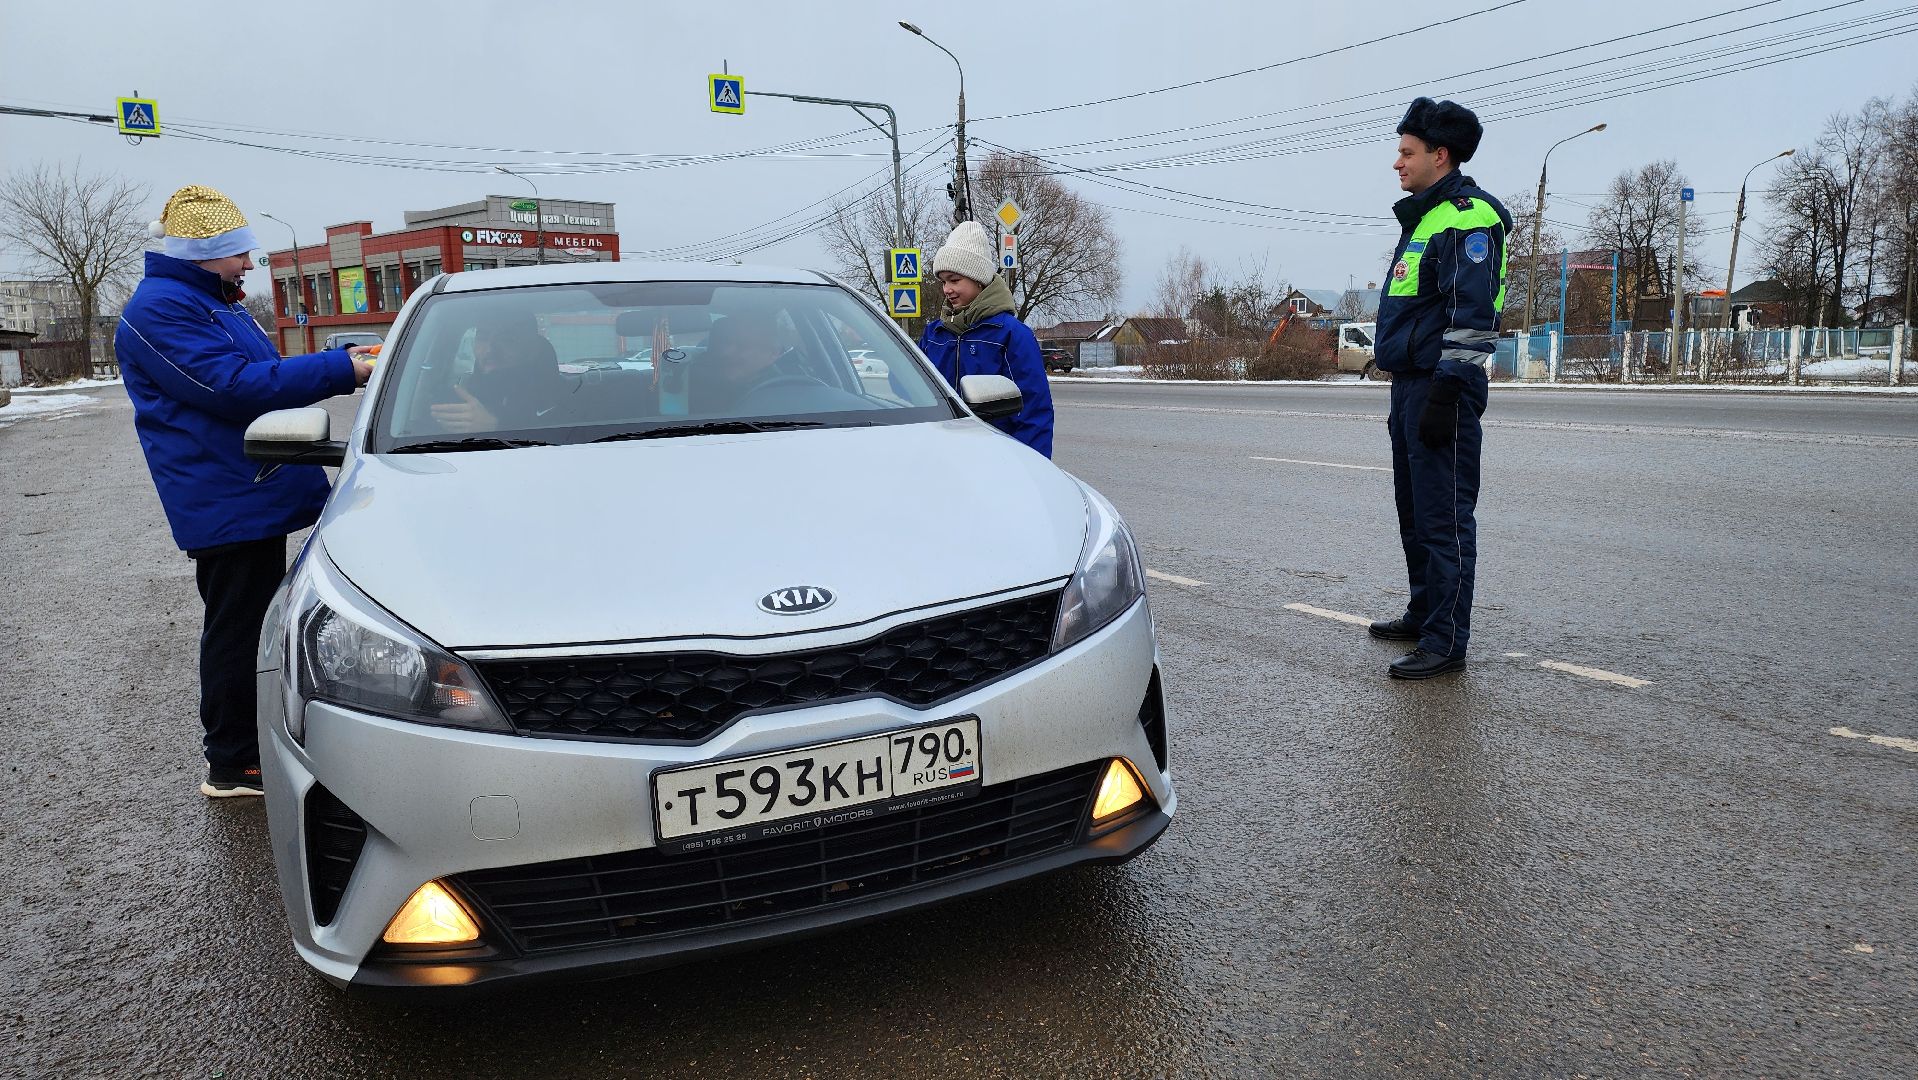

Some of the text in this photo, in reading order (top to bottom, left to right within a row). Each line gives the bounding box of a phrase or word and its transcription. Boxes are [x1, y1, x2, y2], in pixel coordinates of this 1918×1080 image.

[509, 210, 601, 226] Цифрвая Техника
[476, 229, 503, 245] FIX
[554, 236, 603, 247] МЕБЕЛЬ
[770, 588, 826, 609] KIA
[893, 727, 965, 774] 790
[913, 767, 948, 786] RUS
[677, 755, 884, 826] Т593КН
[762, 808, 874, 836] FAVORIT MOTORS
[682, 840, 704, 851] (495)
[723, 835, 734, 843] 25
